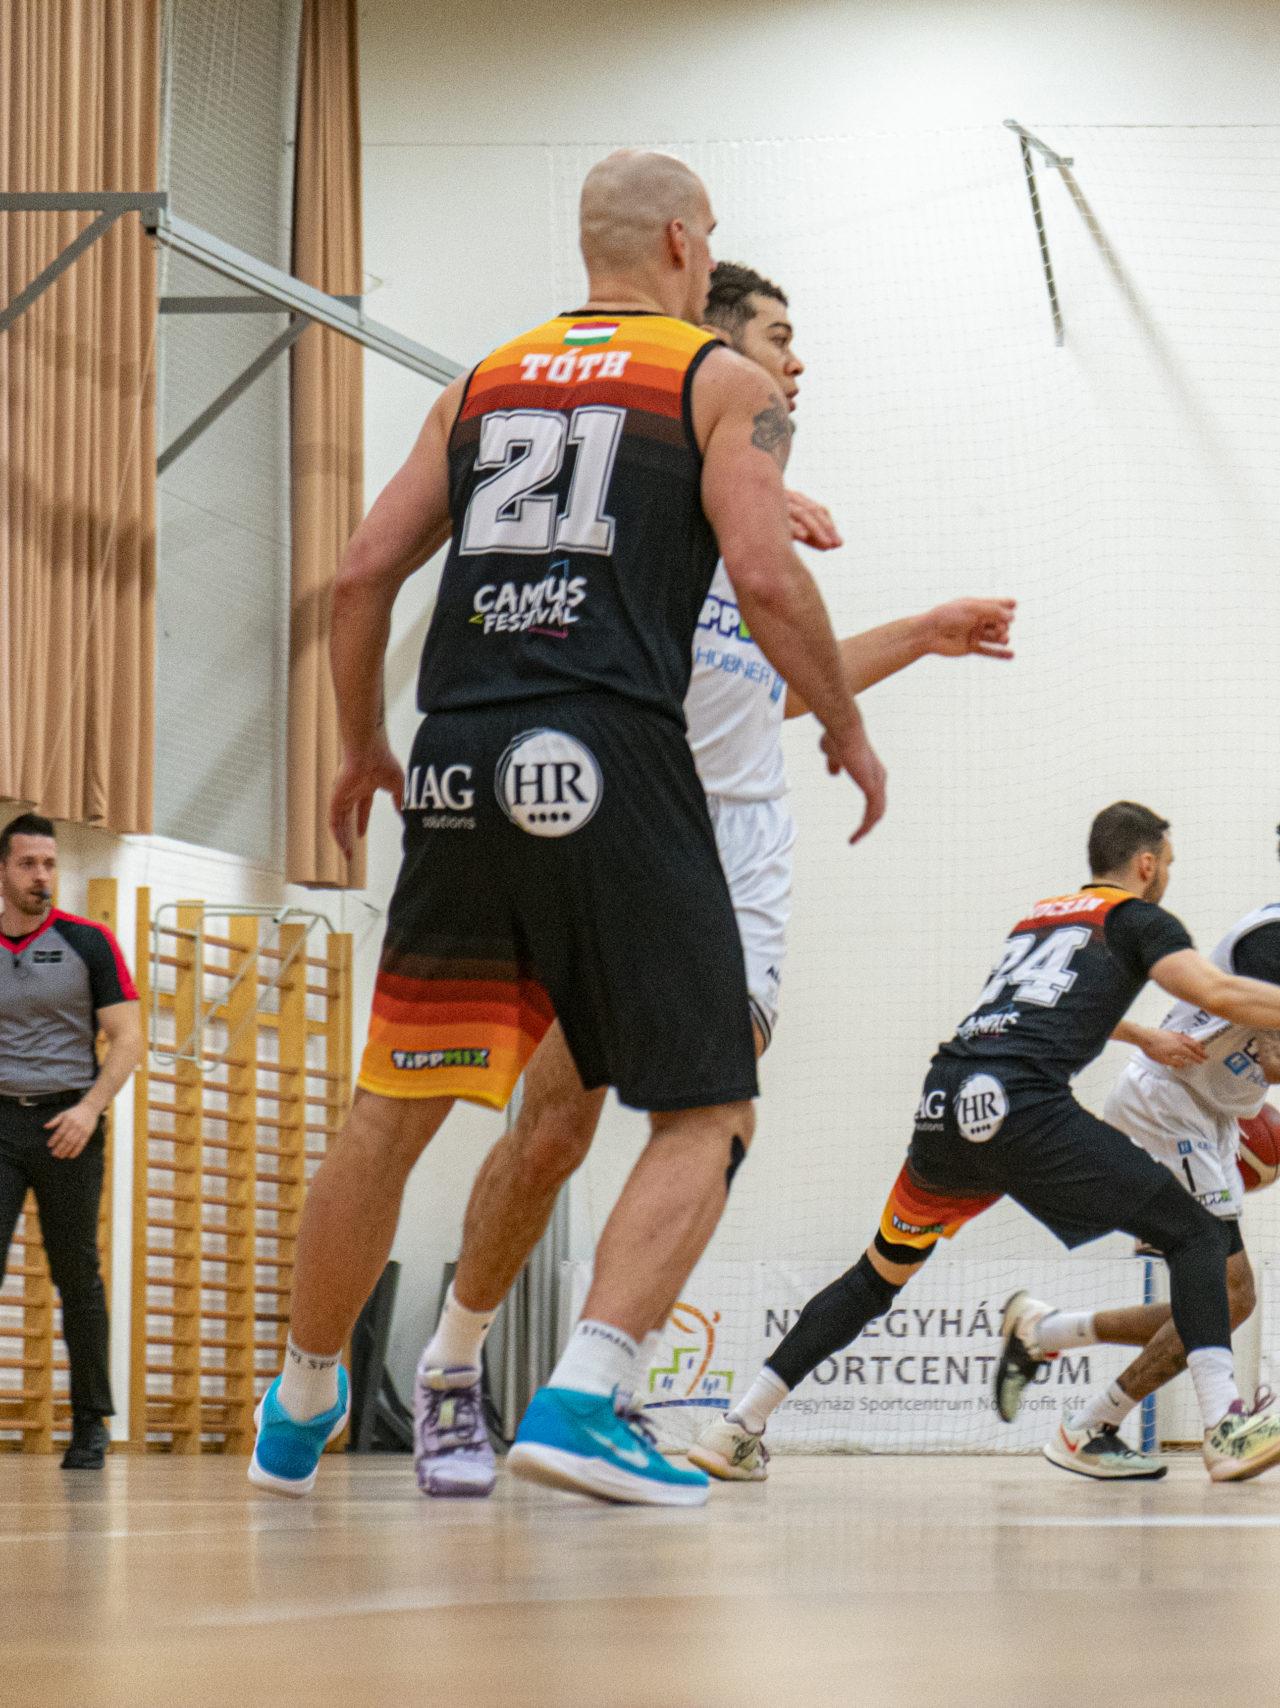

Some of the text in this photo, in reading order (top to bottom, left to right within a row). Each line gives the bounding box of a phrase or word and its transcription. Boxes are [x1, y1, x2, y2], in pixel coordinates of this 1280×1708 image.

[519, 347, 632, 384] TÓTH
[459, 404, 627, 557] 21
[473, 575, 588, 614] CAMUS
[511, 761, 590, 806] HR
[961, 1091, 1000, 1125] HR
[1182, 1156, 1197, 1193] 1
